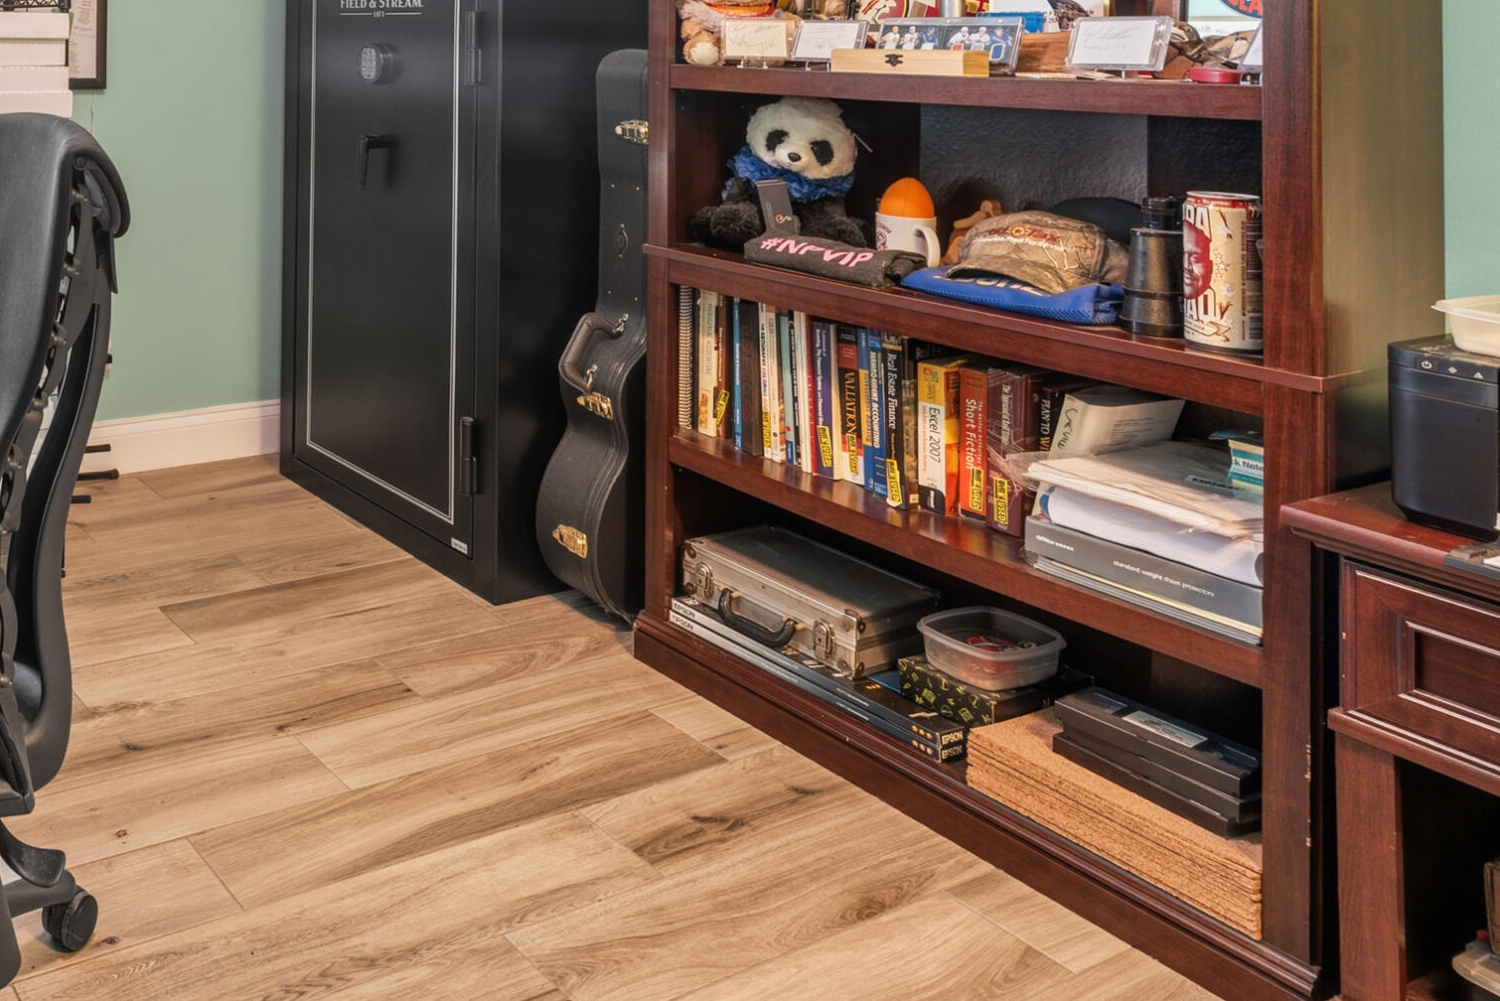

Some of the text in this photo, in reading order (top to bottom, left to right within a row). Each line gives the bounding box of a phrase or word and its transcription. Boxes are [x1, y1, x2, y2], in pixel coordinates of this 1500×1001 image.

[844, 372, 857, 435] VALUATION
[887, 352, 898, 430] Real Estate Finance
[871, 402, 880, 449] ACCOUNTING
[929, 406, 940, 463] Excel 2007
[964, 398, 977, 470] Short Fiction
[1040, 422, 1050, 435] TO
[1040, 436, 1050, 451] WI
[674, 602, 696, 619] EPSON
[941, 730, 964, 745] EPSON
